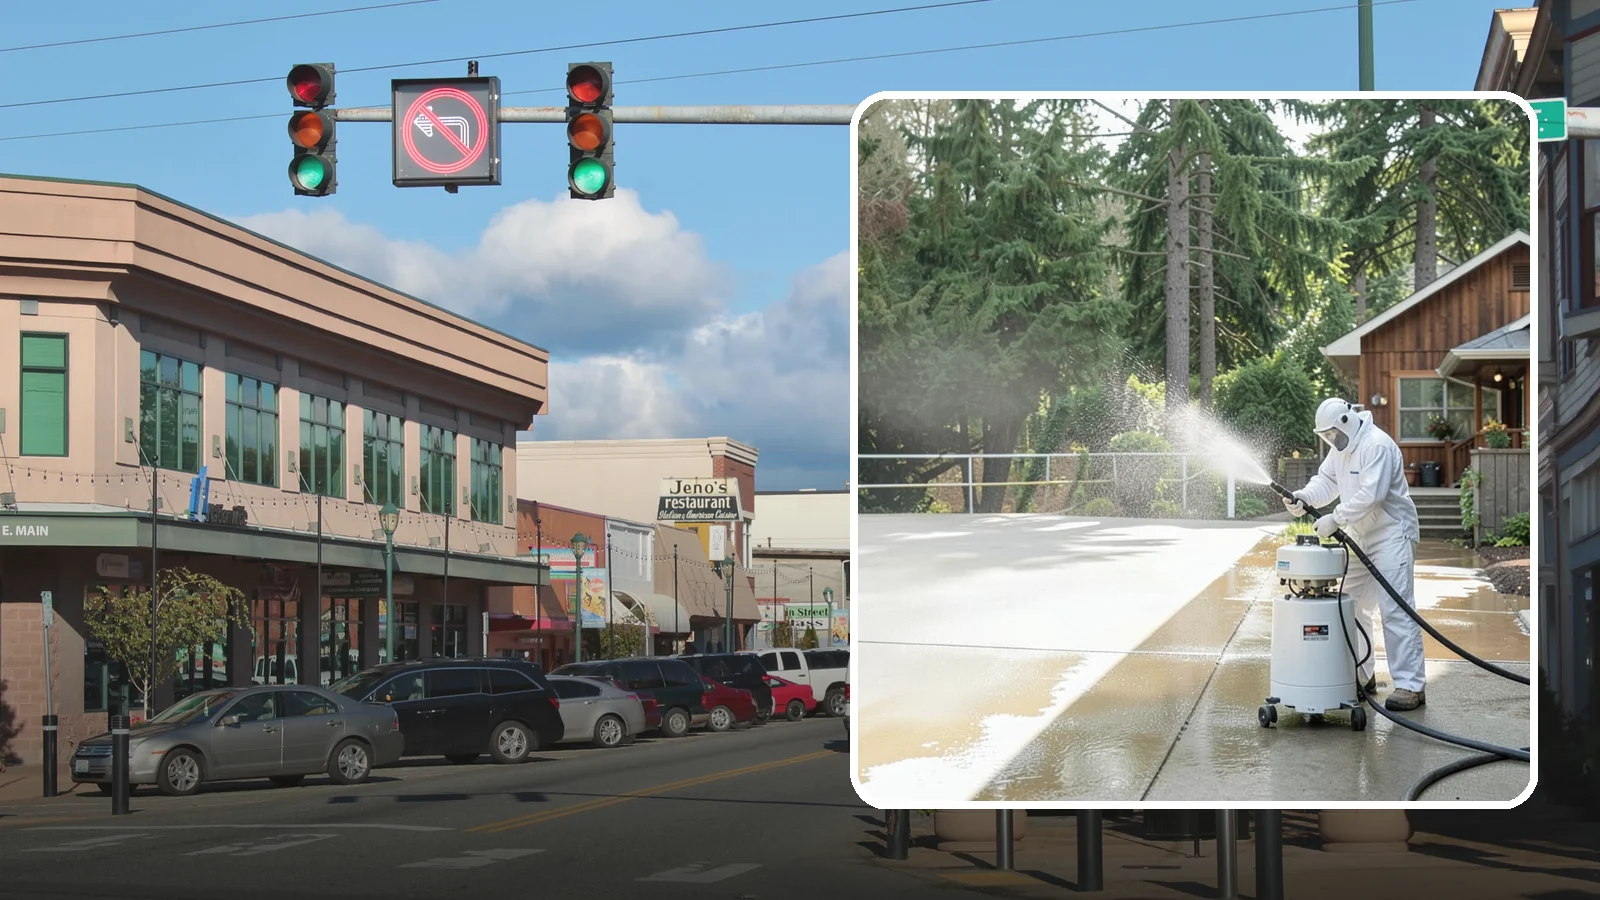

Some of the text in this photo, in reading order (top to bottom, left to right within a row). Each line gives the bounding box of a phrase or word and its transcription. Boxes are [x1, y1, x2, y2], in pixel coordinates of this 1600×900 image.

[669, 479, 727, 495] Jeno's
[665, 496, 731, 509] restaurant
[659, 509, 681, 519] Italian
[686, 509, 714, 519] American
[715, 509, 738, 519] Cuisine
[2, 525, 49, 536] E. MAIN
[785, 607, 829, 617] in Street
